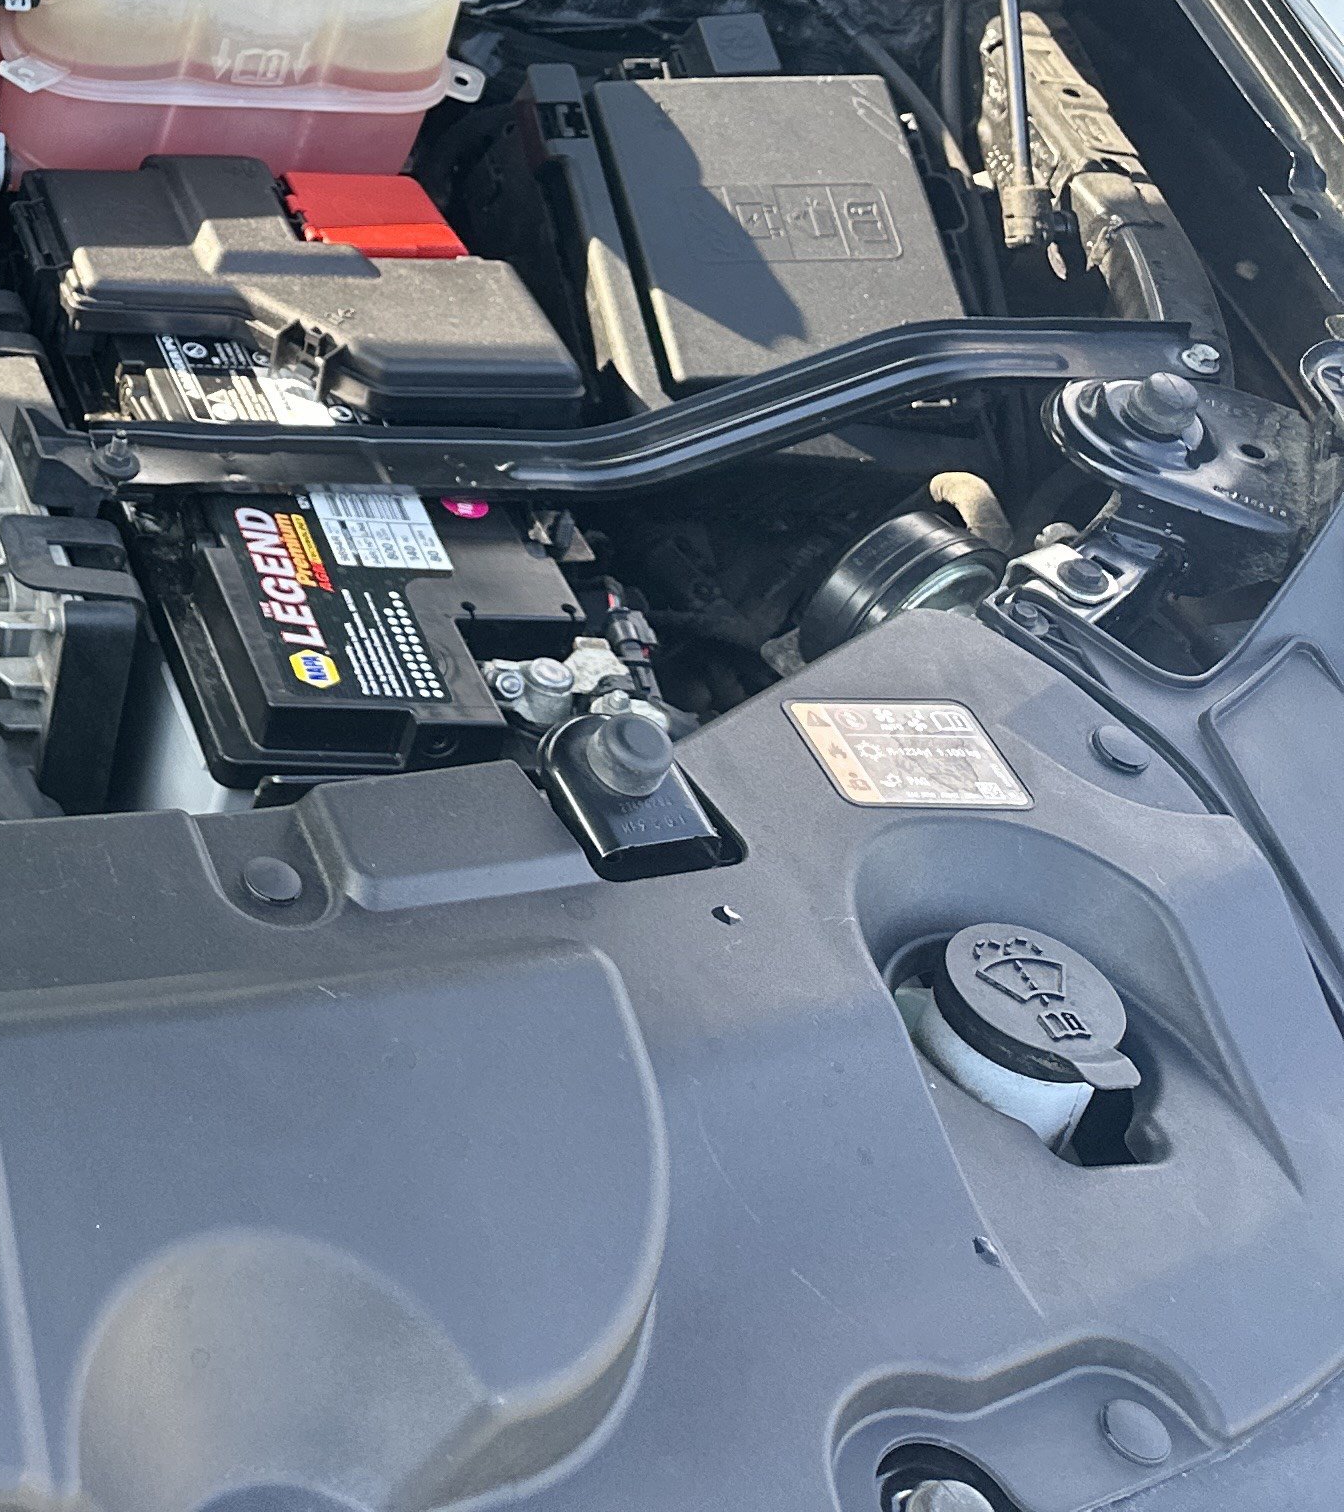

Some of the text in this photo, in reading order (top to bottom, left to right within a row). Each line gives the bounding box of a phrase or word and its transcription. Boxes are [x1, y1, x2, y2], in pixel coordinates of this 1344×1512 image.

[234, 507, 329, 682] NAPA LEGEND
[274, 512, 318, 587] Premium
